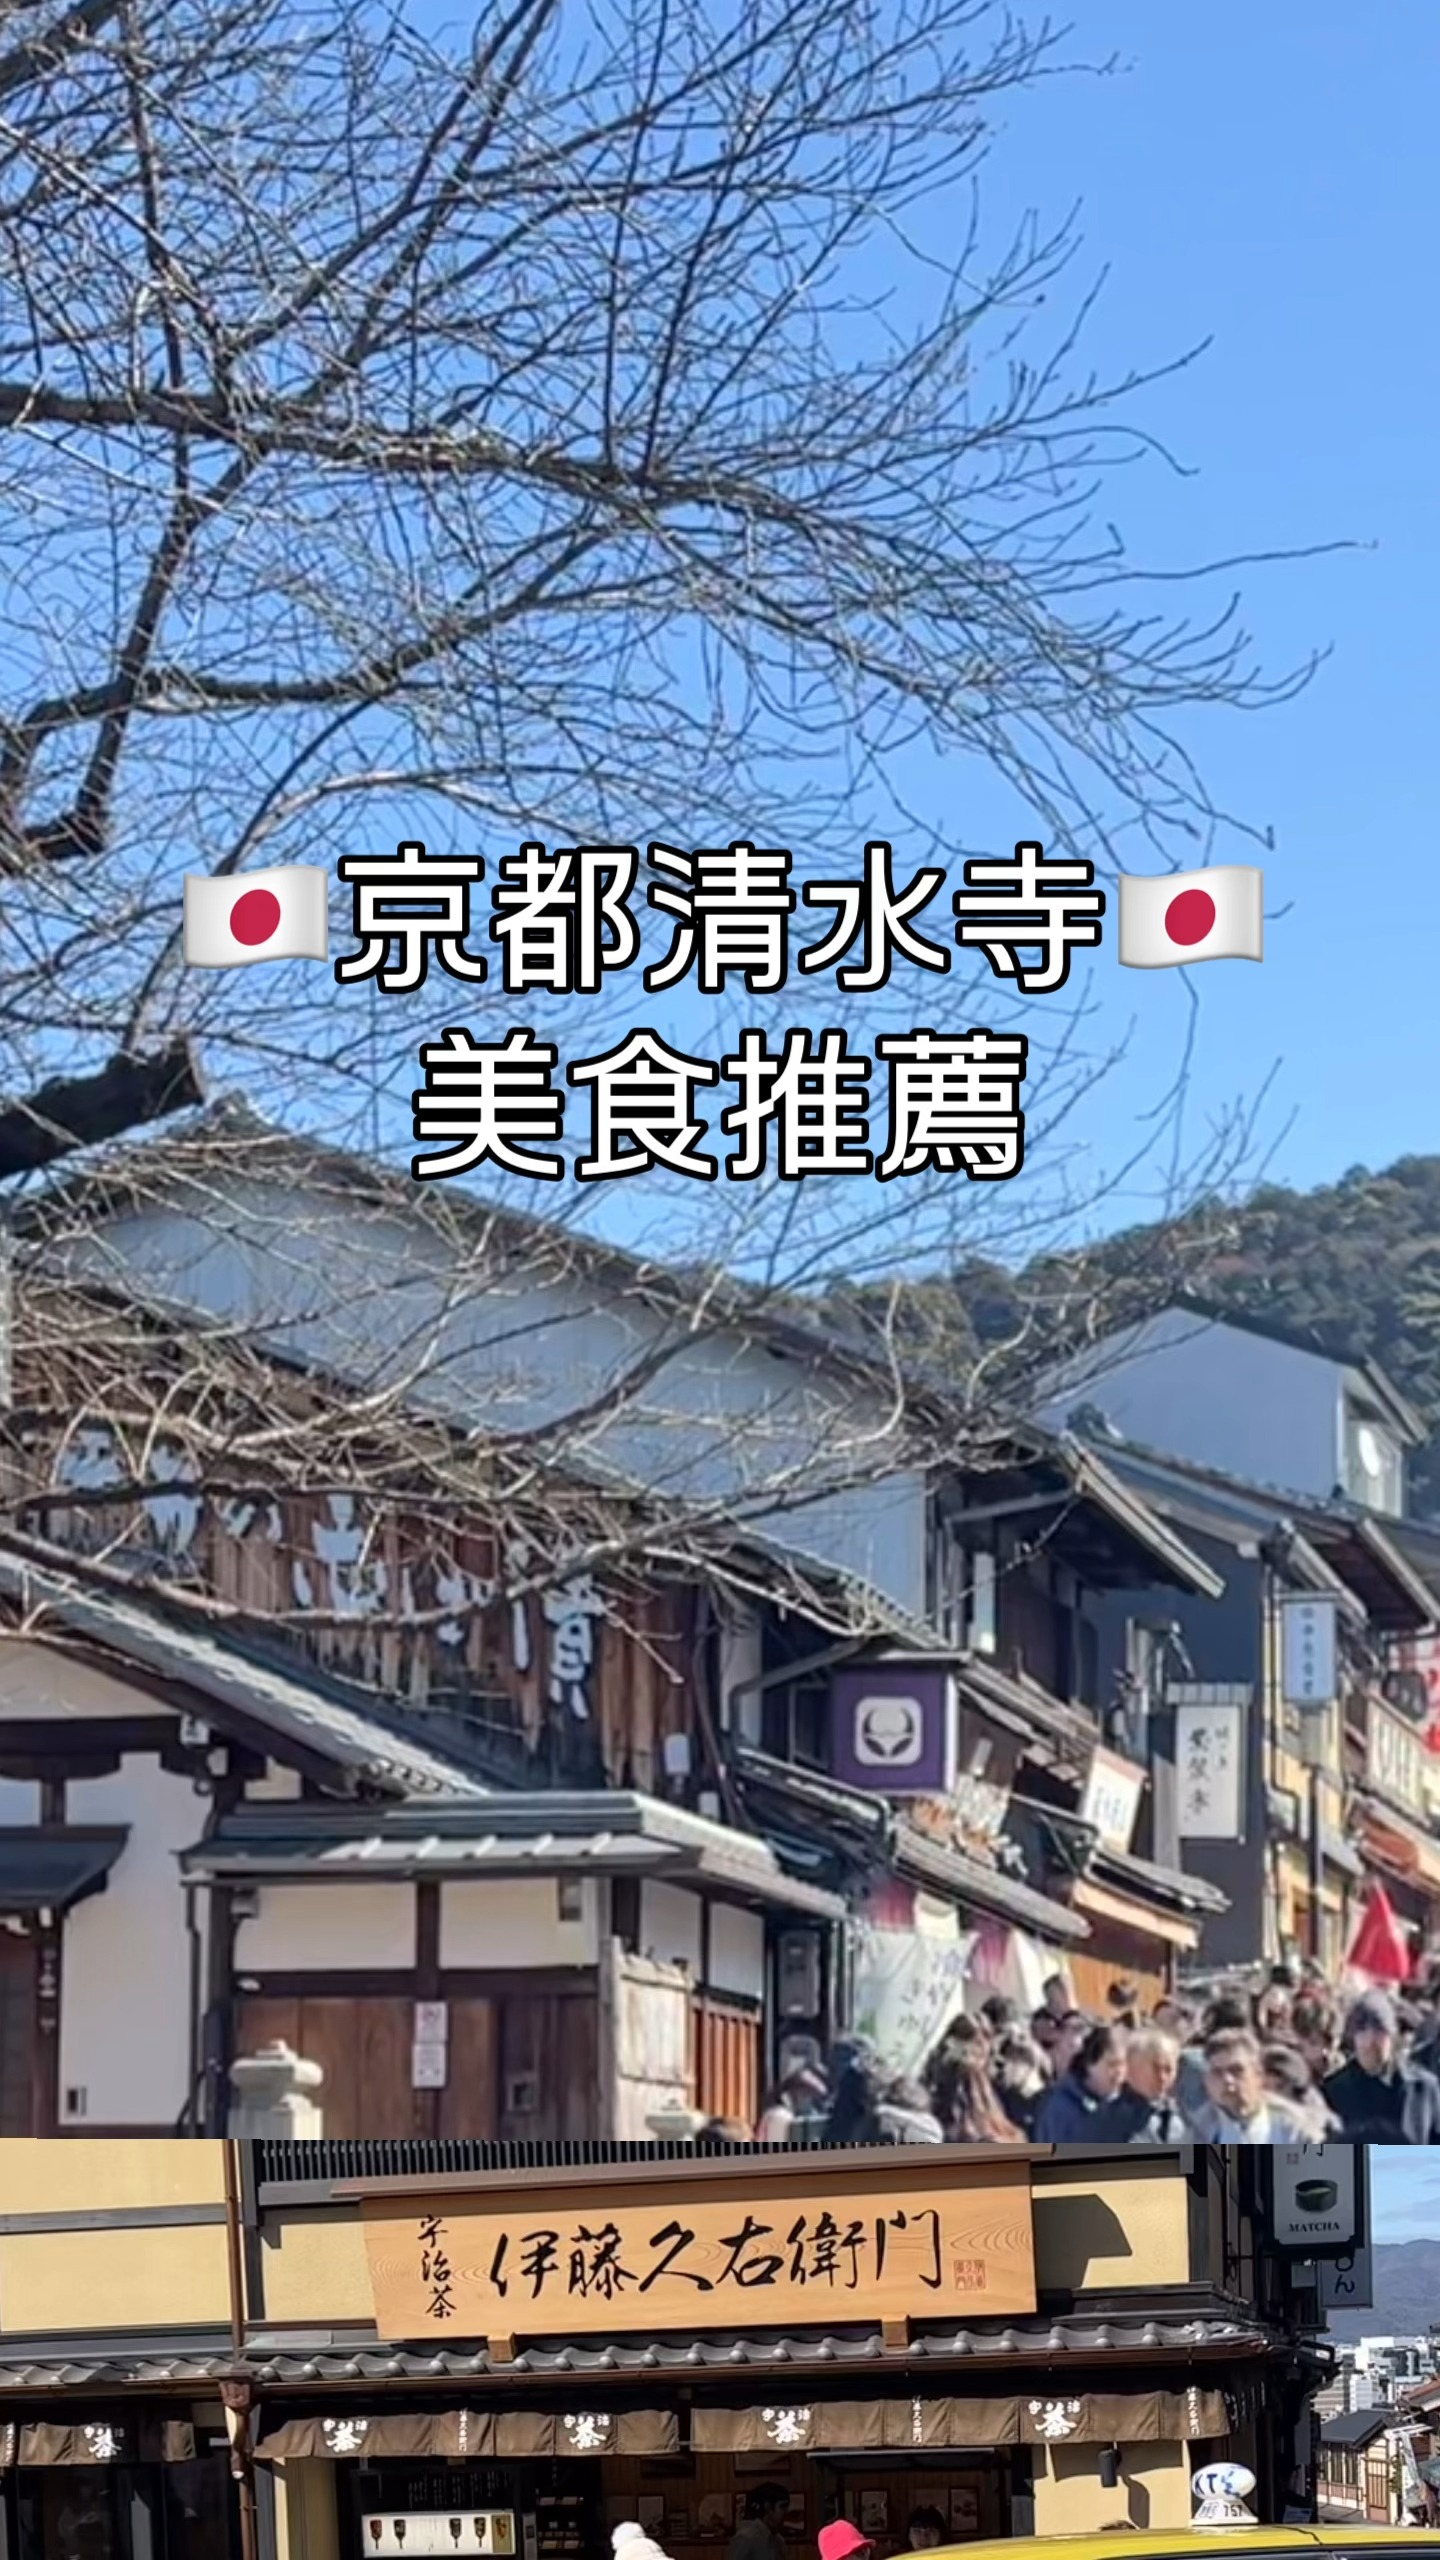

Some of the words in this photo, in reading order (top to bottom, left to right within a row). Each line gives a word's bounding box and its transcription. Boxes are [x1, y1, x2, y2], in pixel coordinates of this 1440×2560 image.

[417, 2213, 457, 2319] 宇治茶
[489, 2208, 942, 2301] 伊藤久右衛門
[1287, 2221, 1341, 2233] MATCHA
